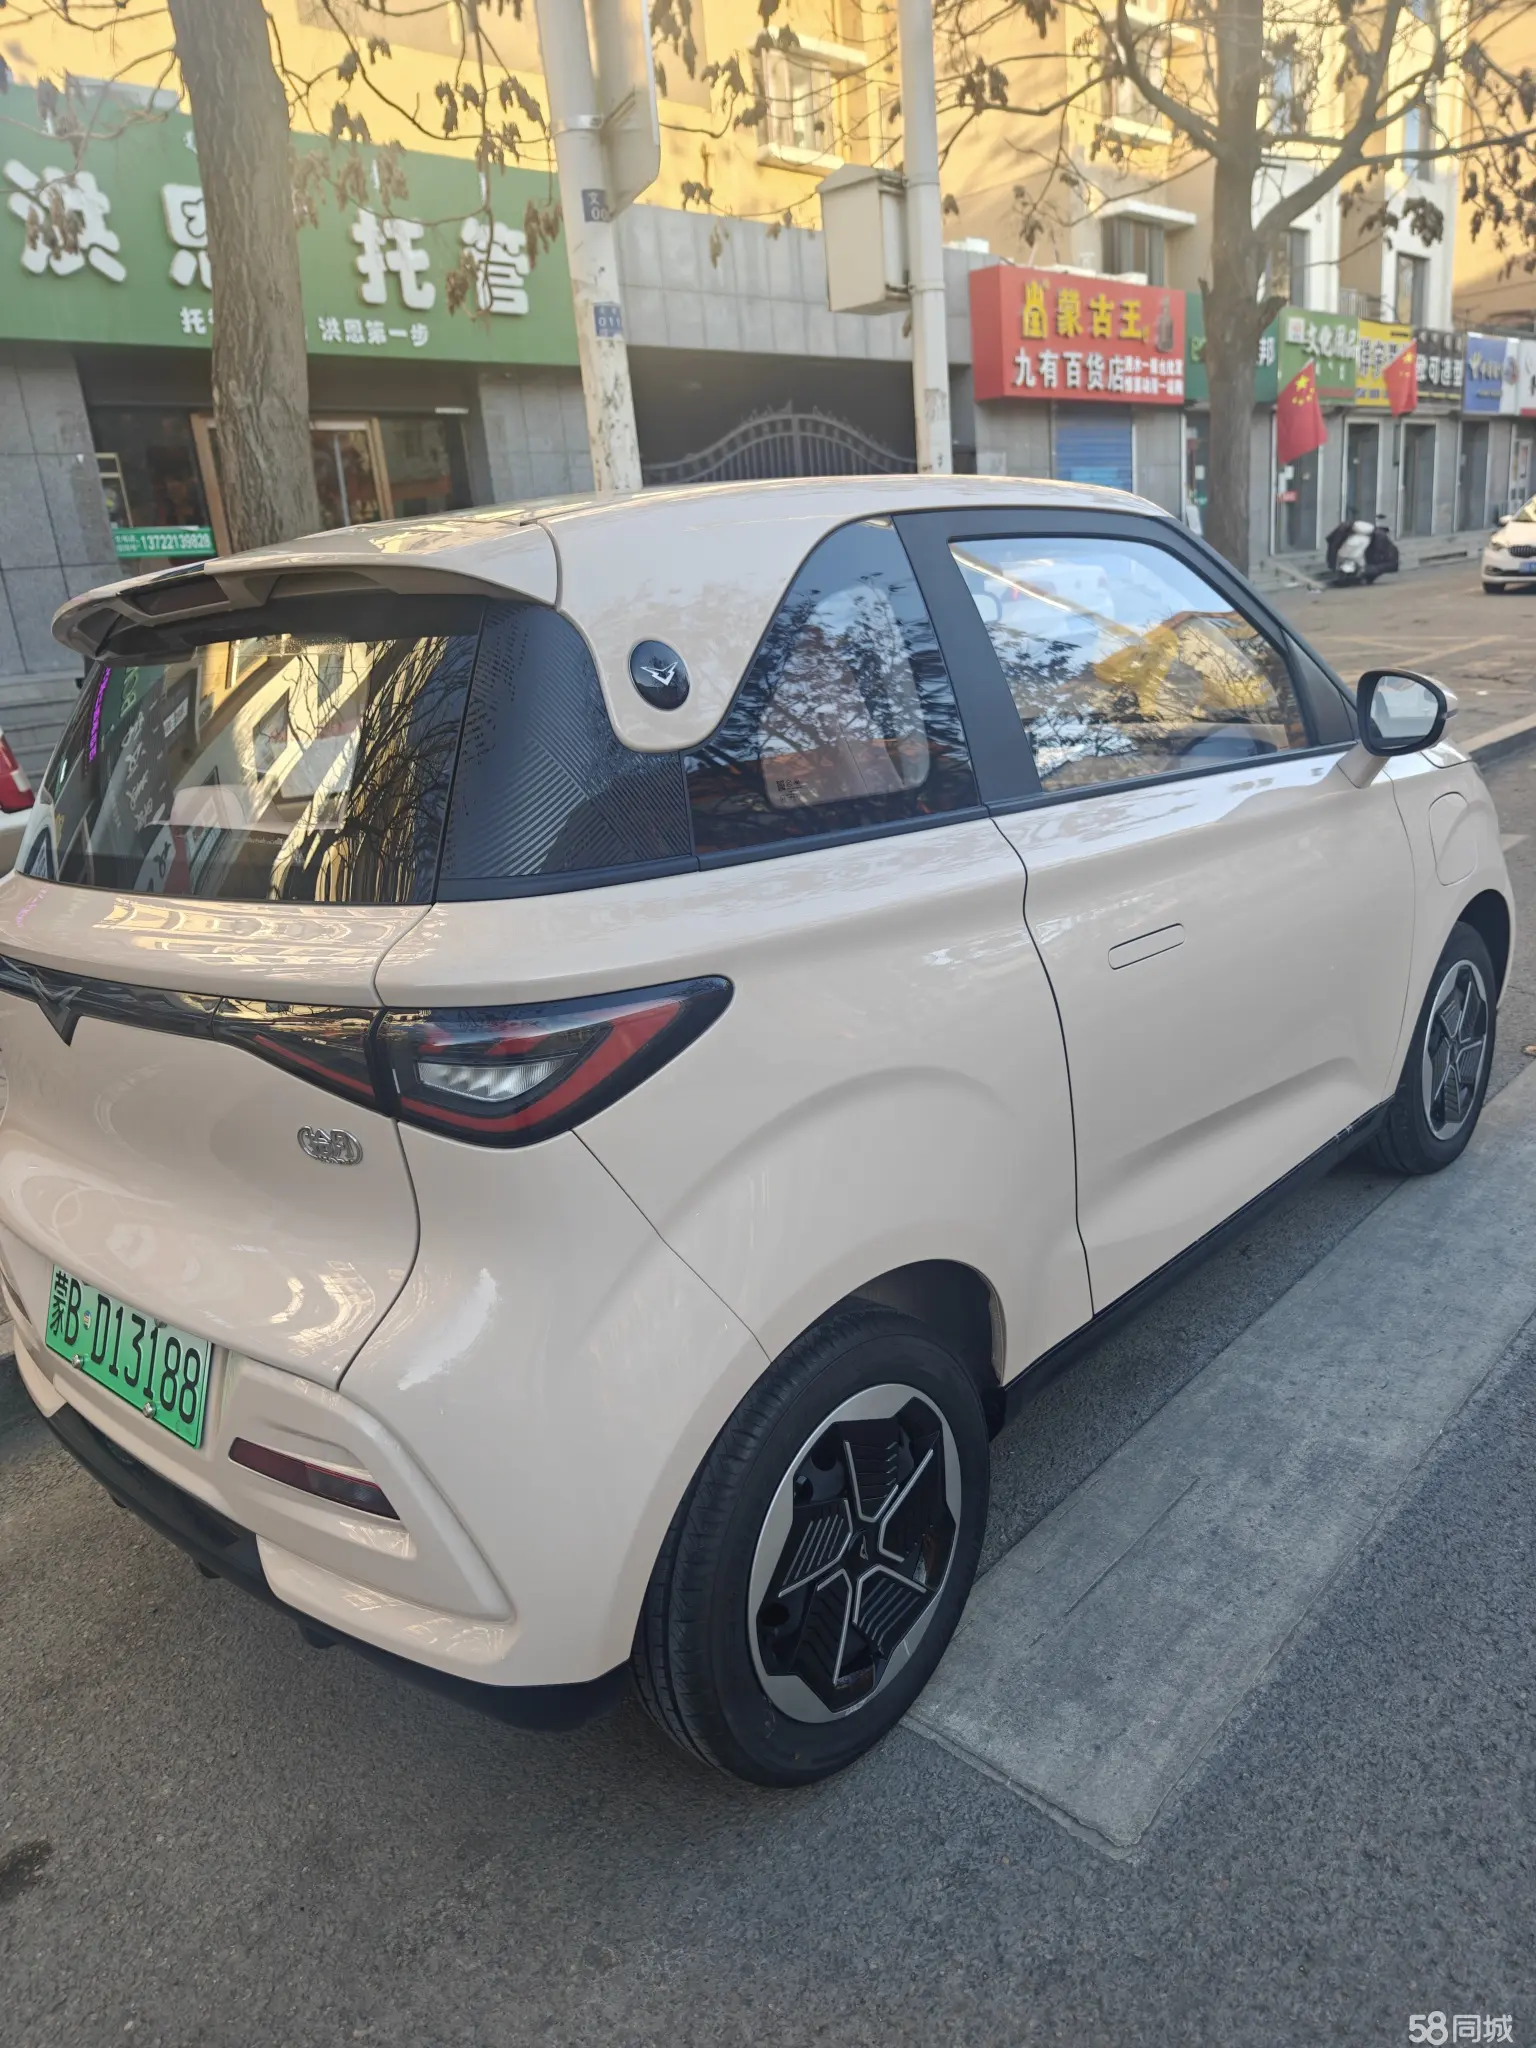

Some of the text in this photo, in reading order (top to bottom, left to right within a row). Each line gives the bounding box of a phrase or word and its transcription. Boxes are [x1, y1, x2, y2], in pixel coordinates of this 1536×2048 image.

[351, 207, 529, 315] 托管
[180, 307, 429, 347] 托 洪恩第一步
[1056, 287, 1143, 339] 蒙古王
[1014, 347, 1126, 394] 九有百货店
[90, 1293, 201, 1424] D13188
